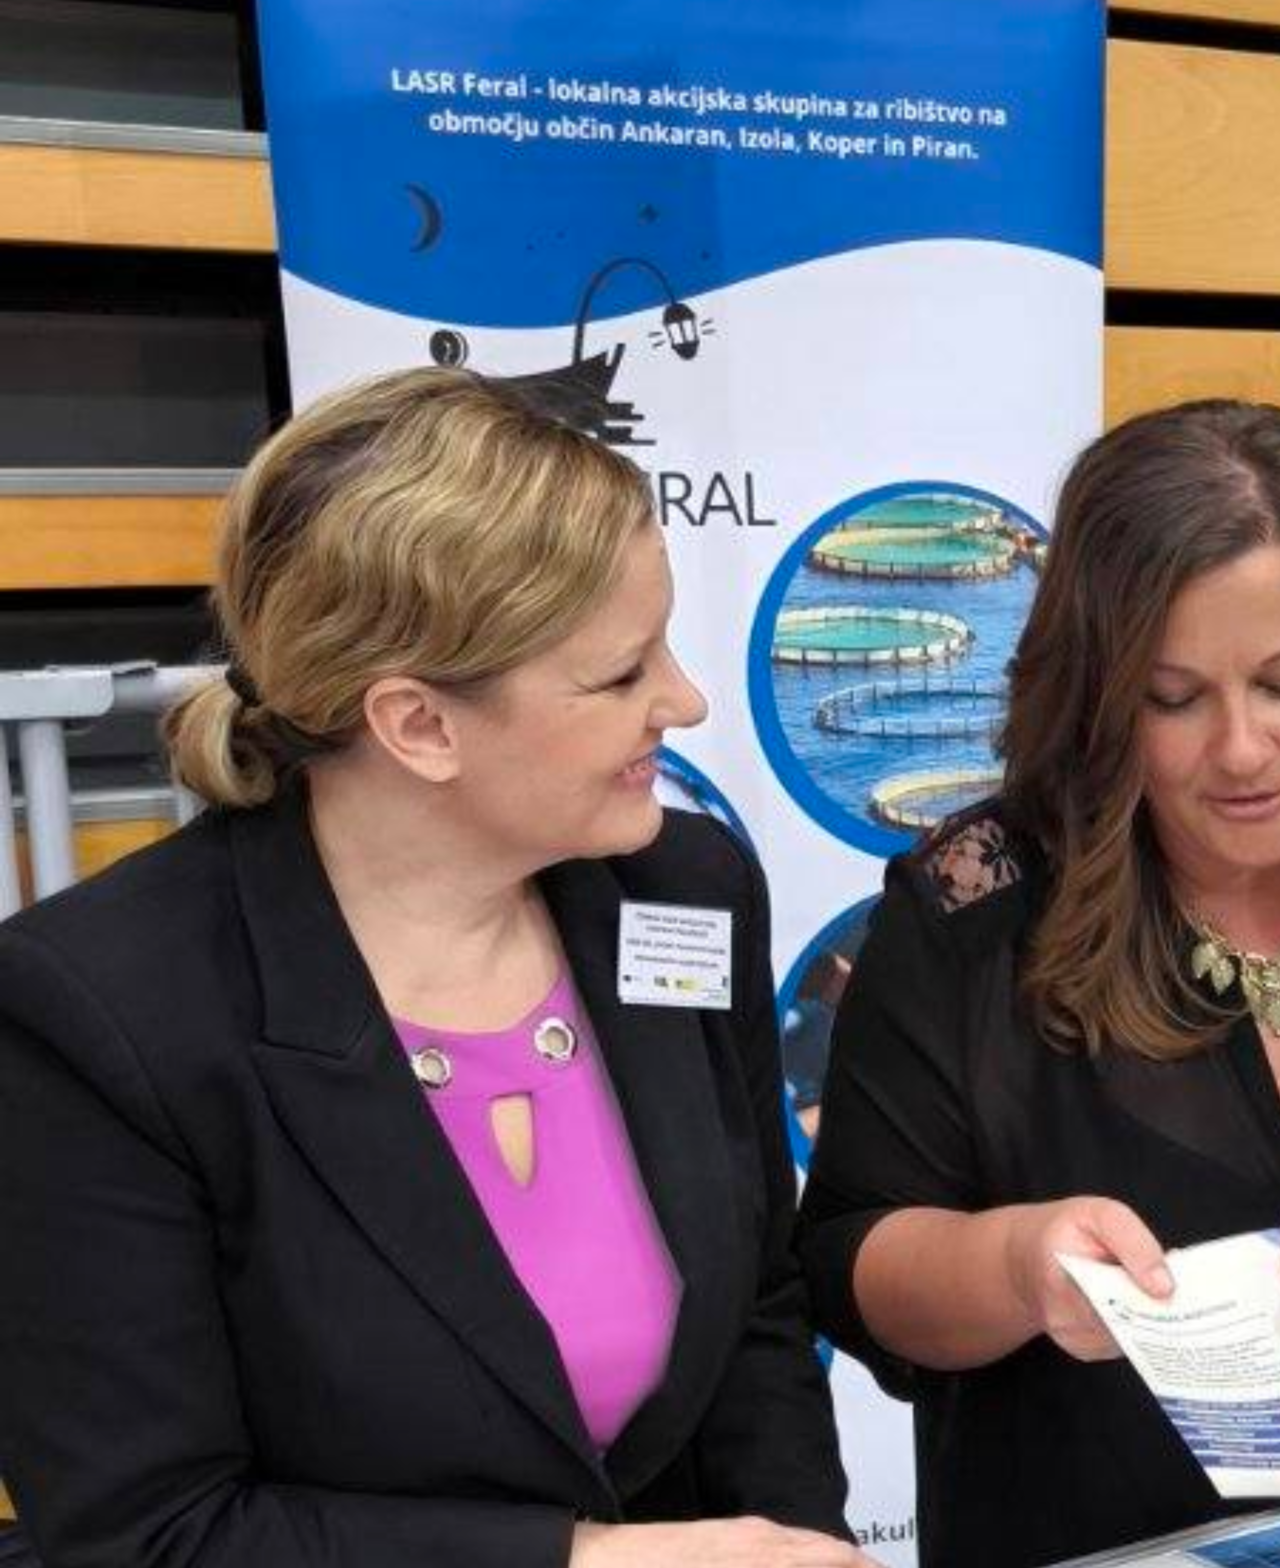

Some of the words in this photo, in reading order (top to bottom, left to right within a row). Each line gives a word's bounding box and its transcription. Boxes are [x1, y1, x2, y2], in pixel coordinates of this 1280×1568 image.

[391, 67, 456, 94] LASR
[463, 72, 527, 98] Feral
[533, 86, 544, 94] -
[549, 78, 641, 106] lokalna
[648, 84, 747, 114] akcijska
[753, 91, 847, 120] skupina
[853, 100, 879, 119] za
[886, 98, 973, 124] ribištvo
[978, 106, 1007, 126] na
[428, 109, 540, 142] območju
[546, 115, 615, 141] občin
[621, 120, 732, 150] Ankaran,
[739, 127, 801, 153] Izola,
[807, 131, 877, 159] Koper
[884, 133, 906, 156] in
[912, 136, 979, 160] Piran.
[659, 471, 777, 527] RAL
[856, 1517, 914, 1545] akul
